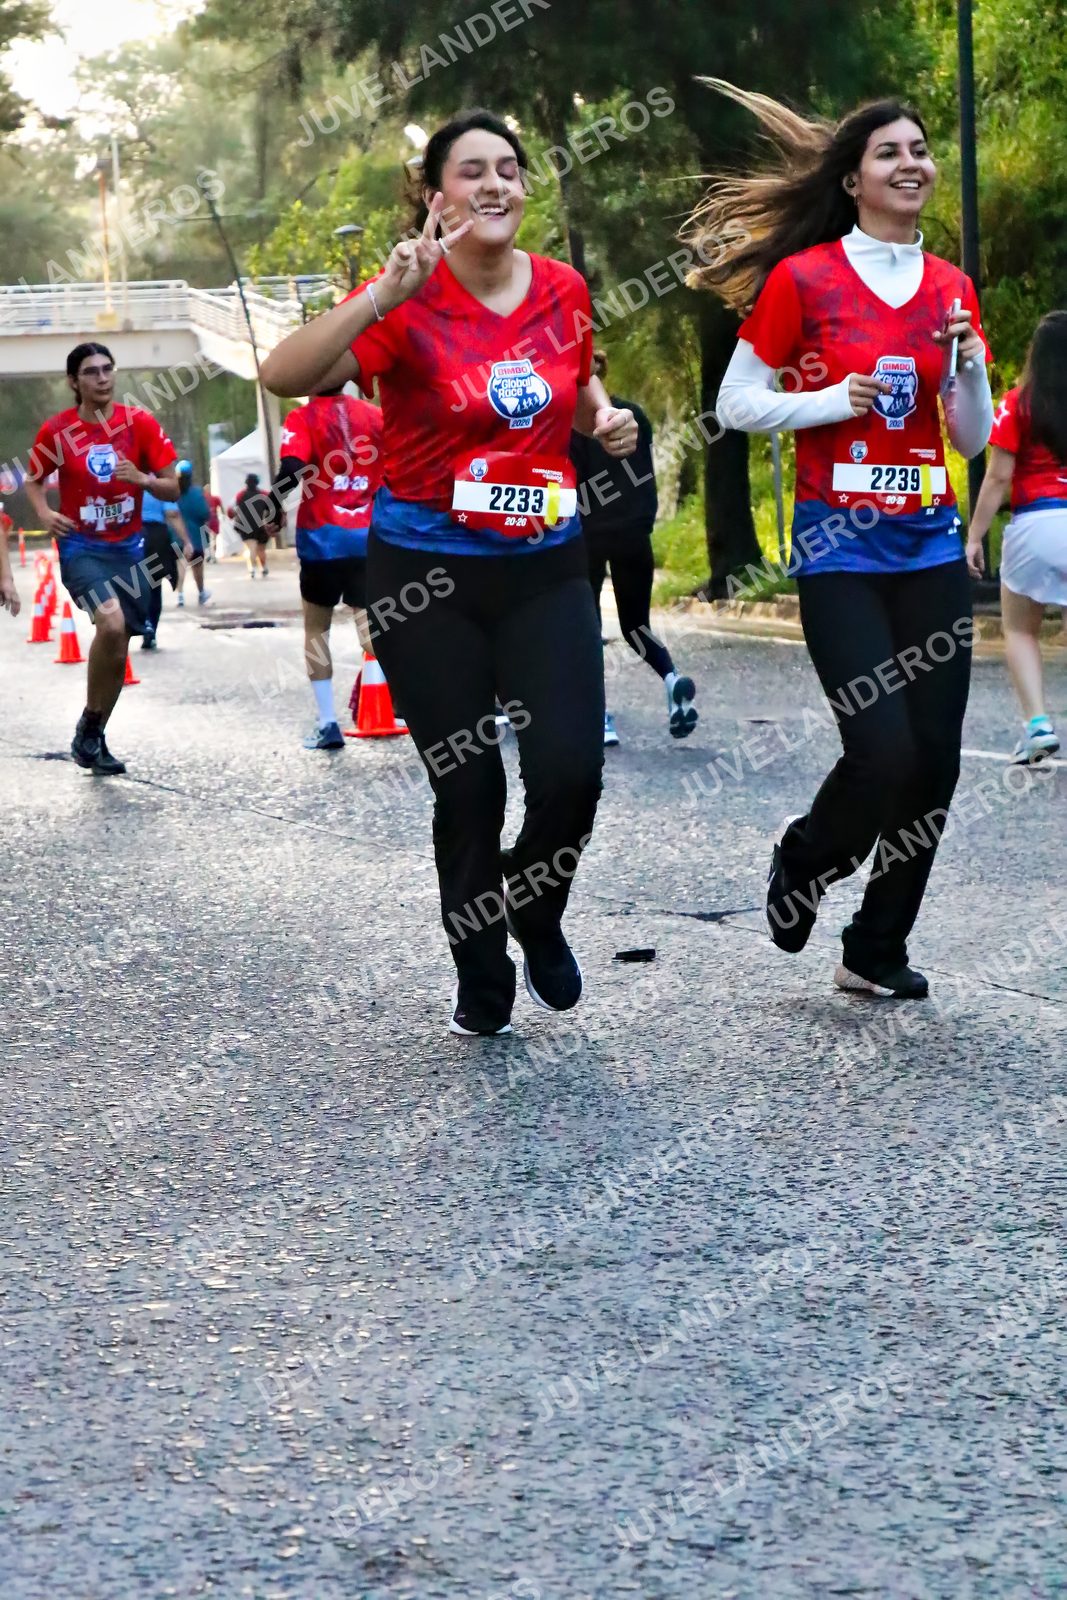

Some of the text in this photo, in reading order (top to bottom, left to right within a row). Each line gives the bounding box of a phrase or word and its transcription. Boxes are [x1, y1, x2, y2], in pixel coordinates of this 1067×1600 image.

[497, 366, 528, 376] BIMBO
[882, 363, 911, 371] BIMBO
[501, 378, 531, 389] Global
[499, 388, 523, 398] Race
[870, 466, 920, 492] 2239
[489, 486, 544, 513] 2233
[885, 496, 907, 505] 20-26
[504, 517, 527, 527] 20-26
